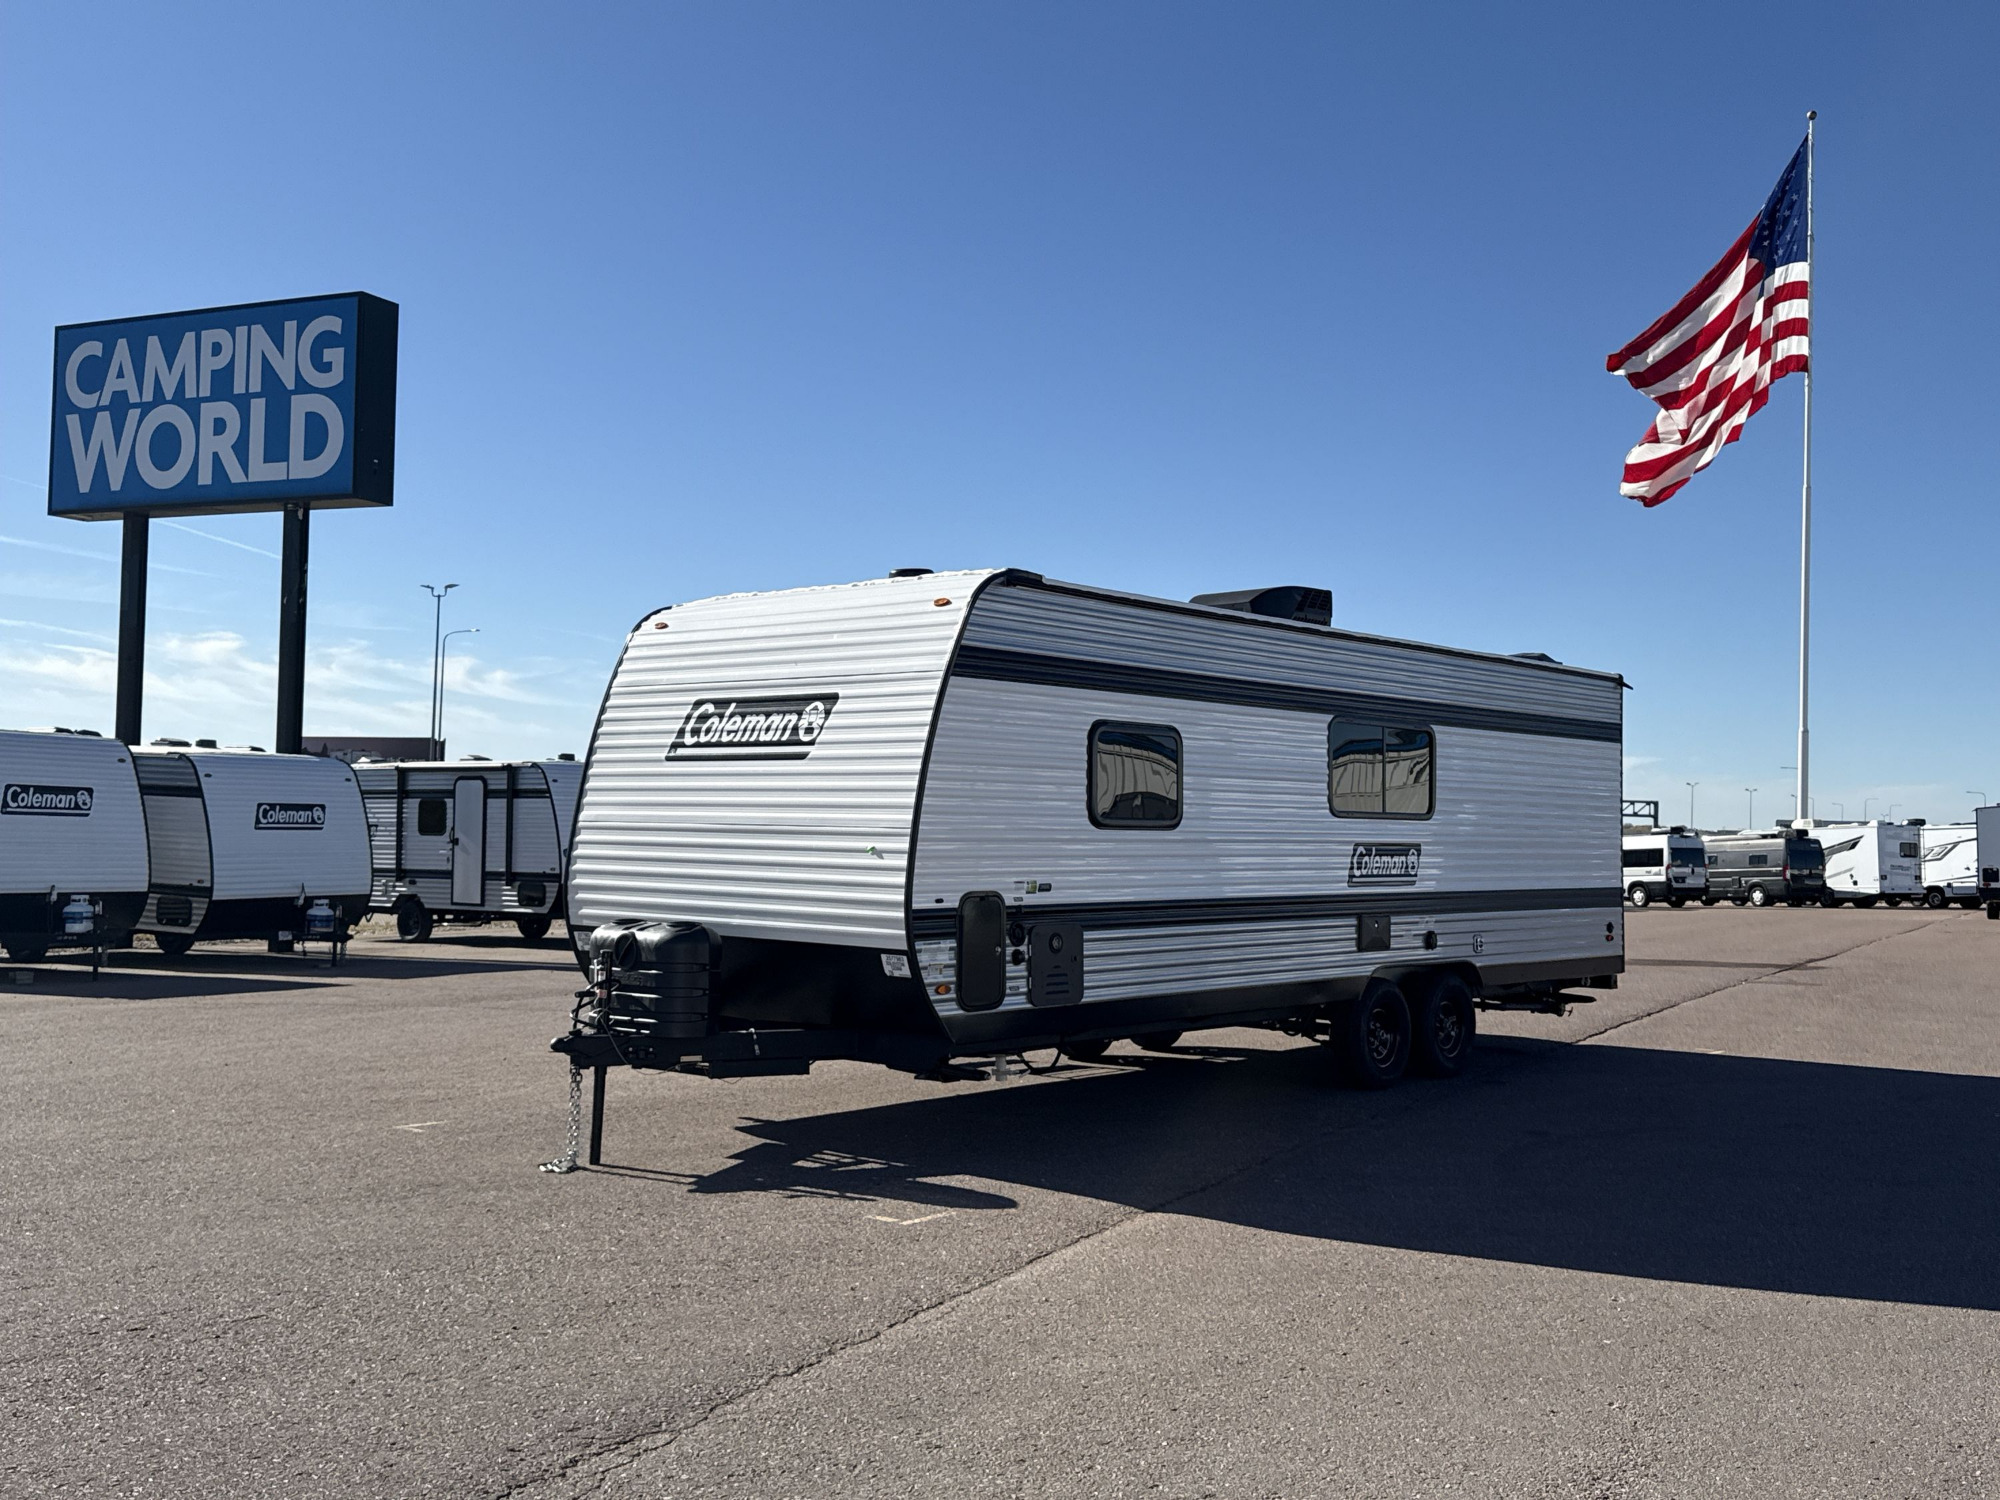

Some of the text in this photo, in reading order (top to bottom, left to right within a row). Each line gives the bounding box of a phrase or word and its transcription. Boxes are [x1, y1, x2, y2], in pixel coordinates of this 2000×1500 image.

[65, 315, 345, 409] CAMPING
[65, 393, 345, 493] WORLD
[684, 702, 798, 746] Coleman
[7, 786, 75, 808] Coleman
[259, 805, 312, 823] Coleman
[1353, 846, 1406, 876] Coleman
